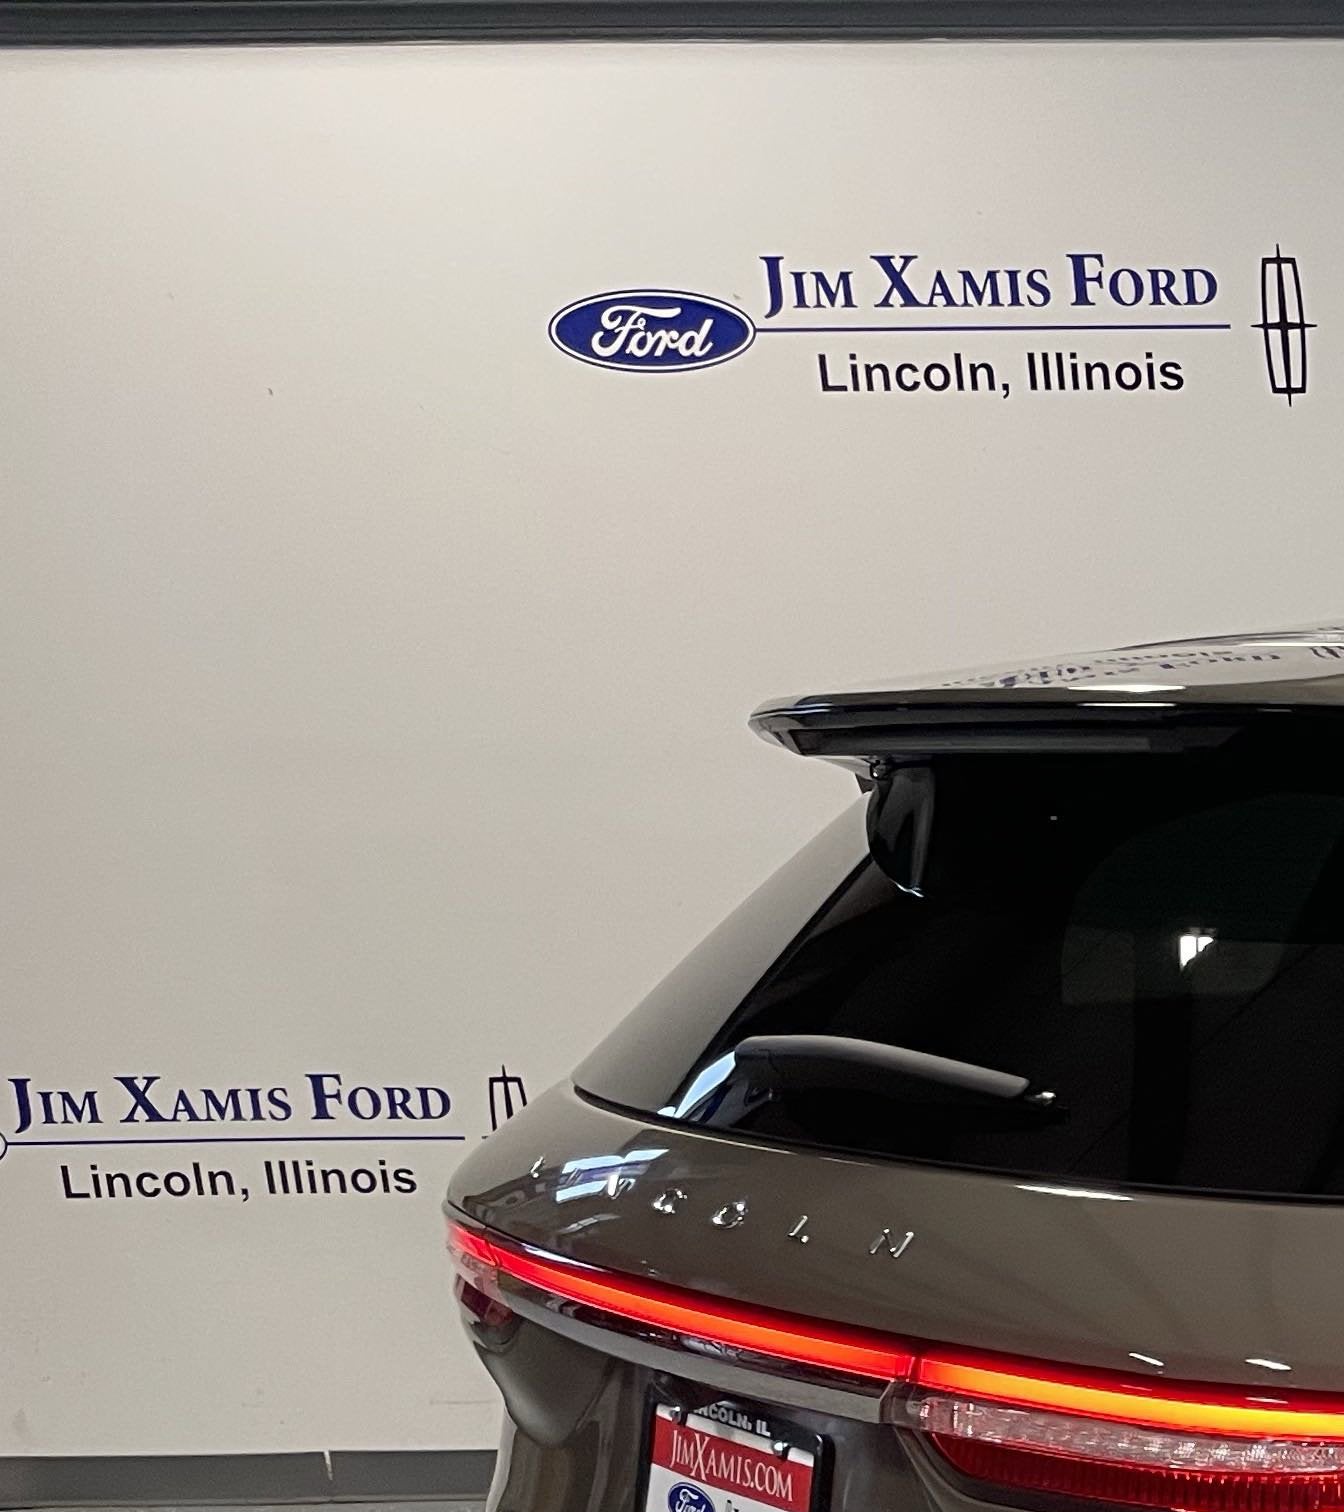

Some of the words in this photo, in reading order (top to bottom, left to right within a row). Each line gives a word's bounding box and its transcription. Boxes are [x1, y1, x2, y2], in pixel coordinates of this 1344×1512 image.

[758, 255, 858, 319] JIM
[870, 254, 1050, 308] XAMIS
[1068, 253, 1217, 307] FORD
[590, 304, 713, 360] Ford
[818, 352, 1010, 400] Lincoln,
[1026, 351, 1184, 391] Illinois
[7, 1077, 104, 1134] JIM
[113, 1075, 292, 1123] XAMIS
[304, 1073, 451, 1121] FORD
[61, 1162, 250, 1203] Lincoln,
[263, 1159, 417, 1195] Illinois
[756, 1419, 771, 1437] IL
